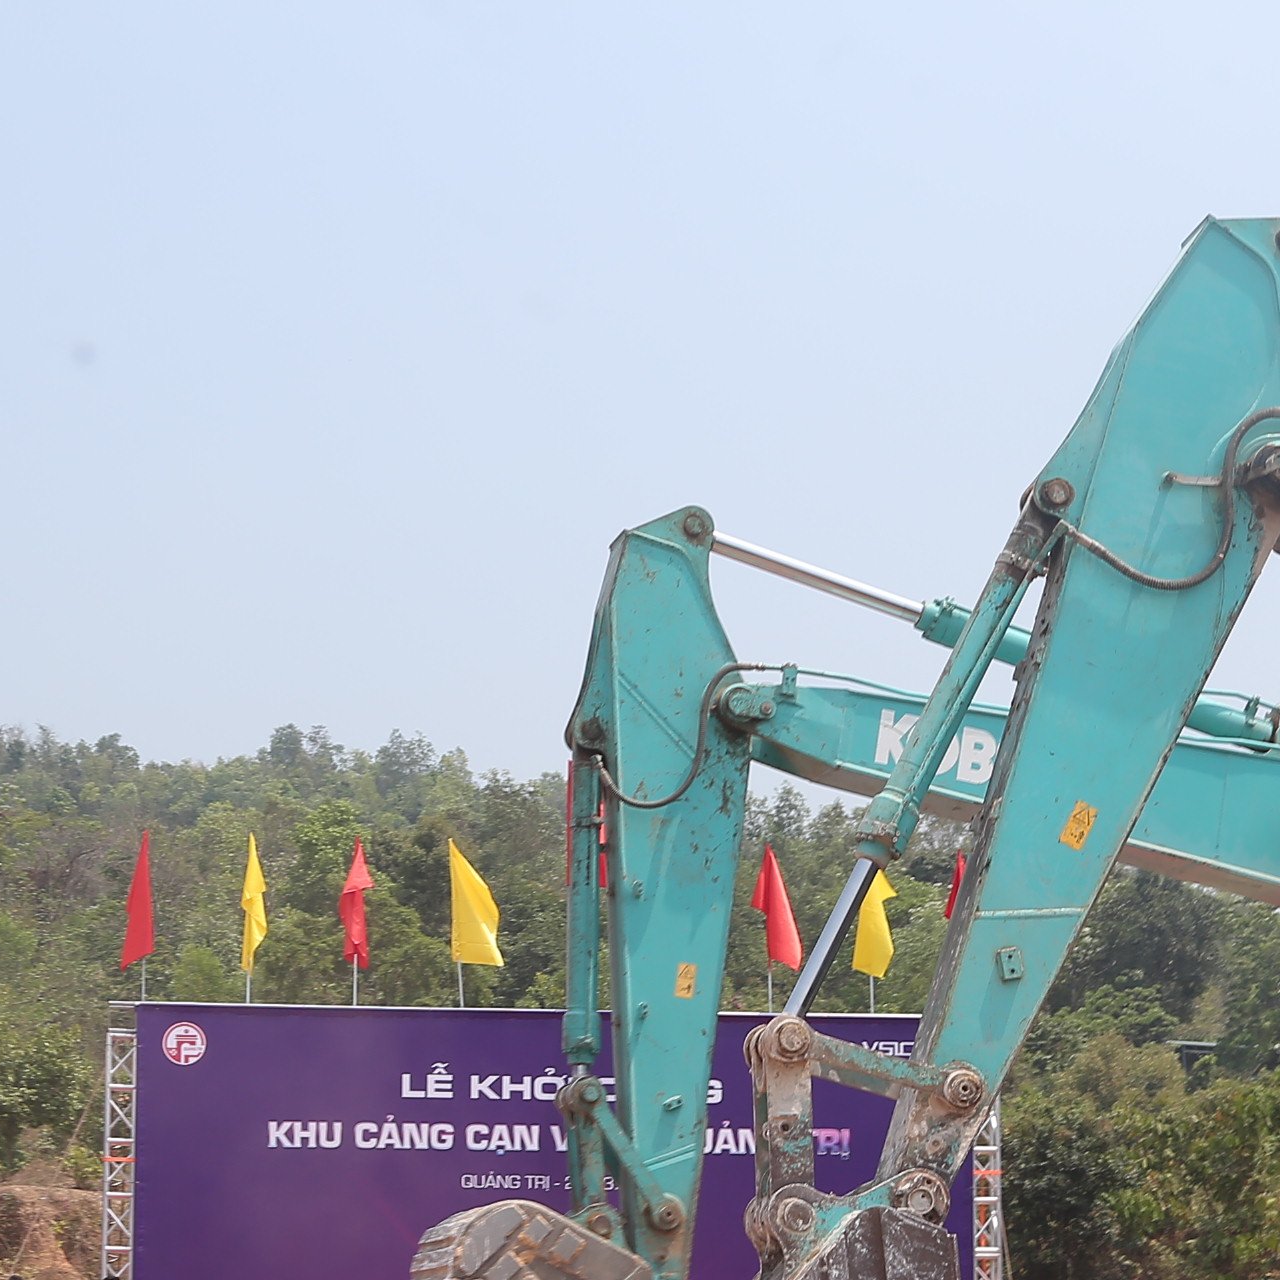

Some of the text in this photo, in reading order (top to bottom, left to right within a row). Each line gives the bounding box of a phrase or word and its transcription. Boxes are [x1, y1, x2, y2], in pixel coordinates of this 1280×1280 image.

[401, 1062, 454, 1099] LỄ
[470, 1067, 573, 1101] KHỞ
[267, 1121, 343, 1149] KHU
[353, 1114, 455, 1150] CẢNG
[465, 1123, 540, 1156] CẠN
[524, 1175, 551, 1191] TRỊ
